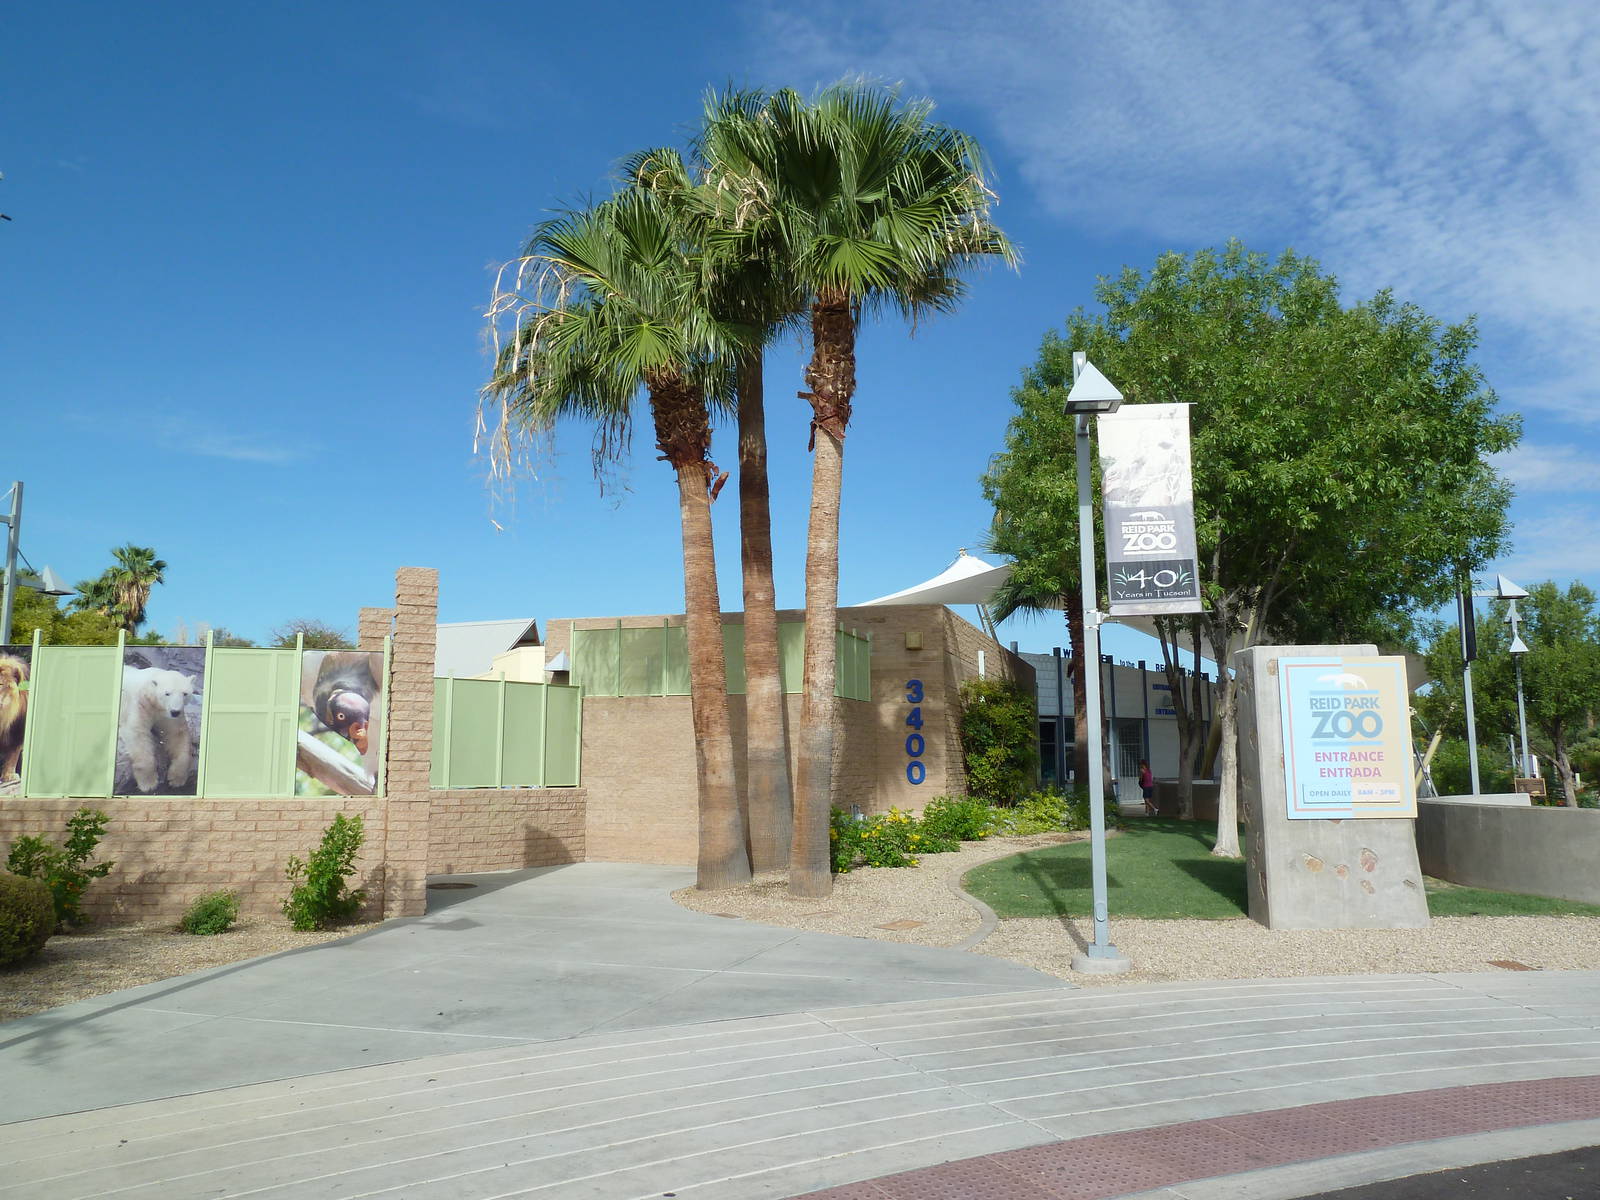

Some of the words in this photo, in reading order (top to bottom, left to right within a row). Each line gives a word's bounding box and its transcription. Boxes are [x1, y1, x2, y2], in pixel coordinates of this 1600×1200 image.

[1122, 525, 1148, 534] REID
[1147, 524, 1175, 533] PARK
[1123, 532, 1177, 551] ZOO
[1127, 569, 1177, 589] 40
[1116, 590, 1144, 599] Years
[1310, 697, 1341, 710] REID
[1344, 696, 1380, 710] PARK
[1310, 710, 1383, 739] ZOO
[906, 679, 926, 785] 3400
[1314, 751, 1385, 762] ENTRANCE
[1319, 767, 1382, 778] ENTRADA
[1331, 789, 1352, 797] DAILY
